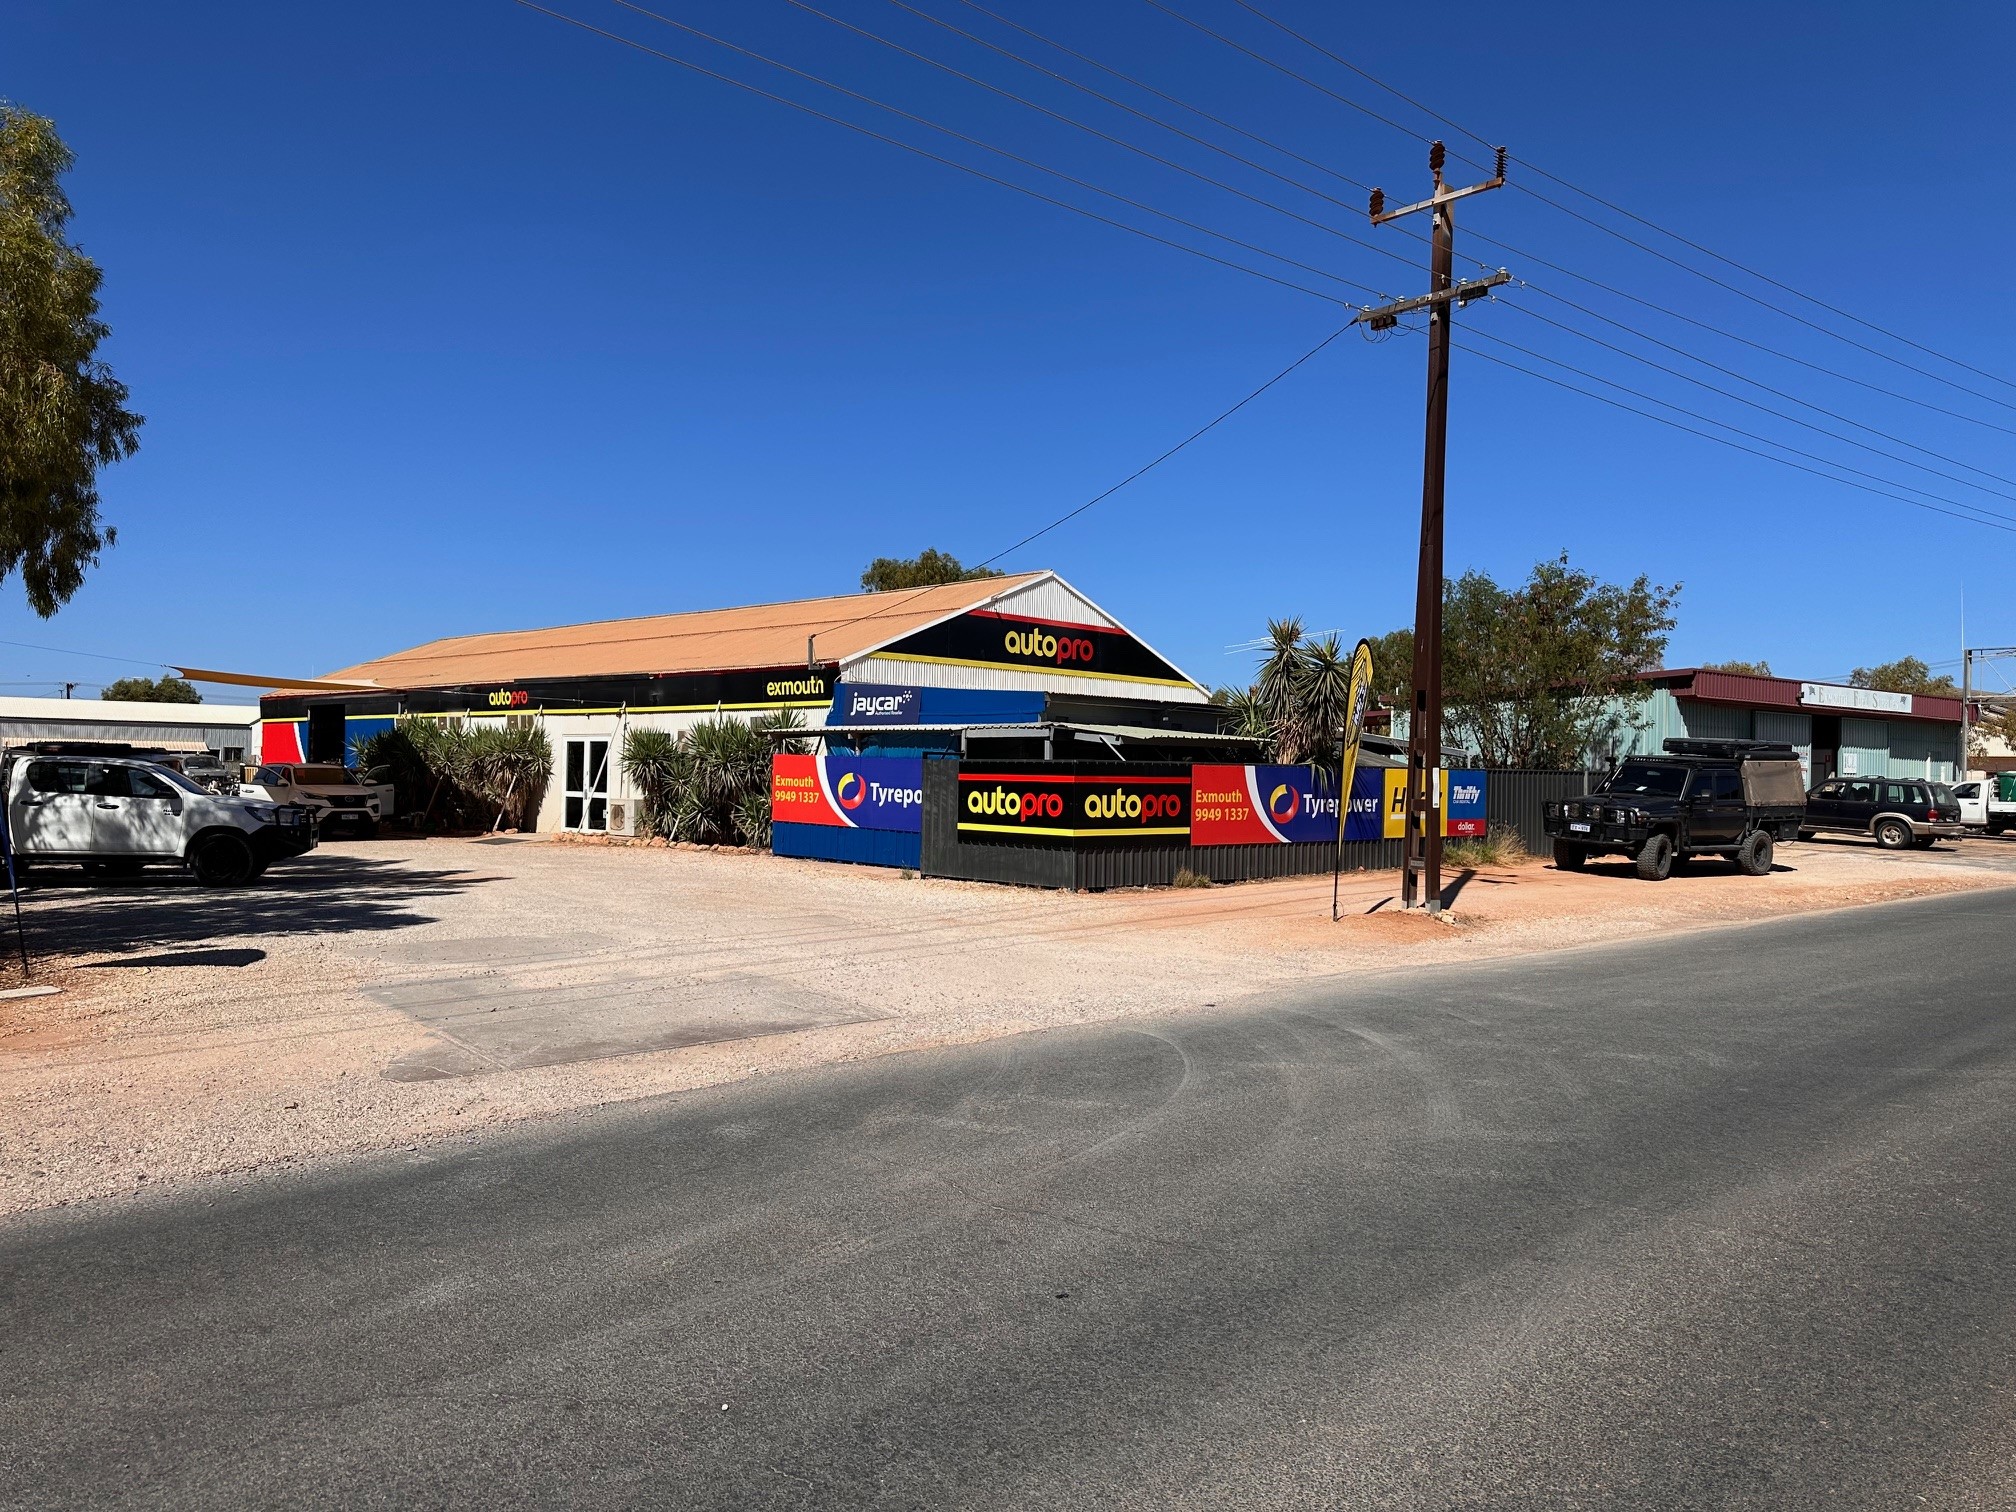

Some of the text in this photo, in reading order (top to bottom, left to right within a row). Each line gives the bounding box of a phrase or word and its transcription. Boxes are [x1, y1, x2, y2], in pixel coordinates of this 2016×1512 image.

[1004, 628, 1094, 664] autopro
[766, 676, 824, 696] exmouth
[489, 688, 528, 708] autopro
[850, 692, 903, 716] jaycar
[775, 774, 814, 788] Exmouth
[774, 790, 819, 803] 9949 1337
[967, 785, 1063, 823] autopro
[1195, 789, 1242, 803] Exmouth
[1452, 785, 1481, 804] Thrifty
[1084, 788, 1181, 824] autopro
[1195, 807, 1249, 821] 9949 1337
